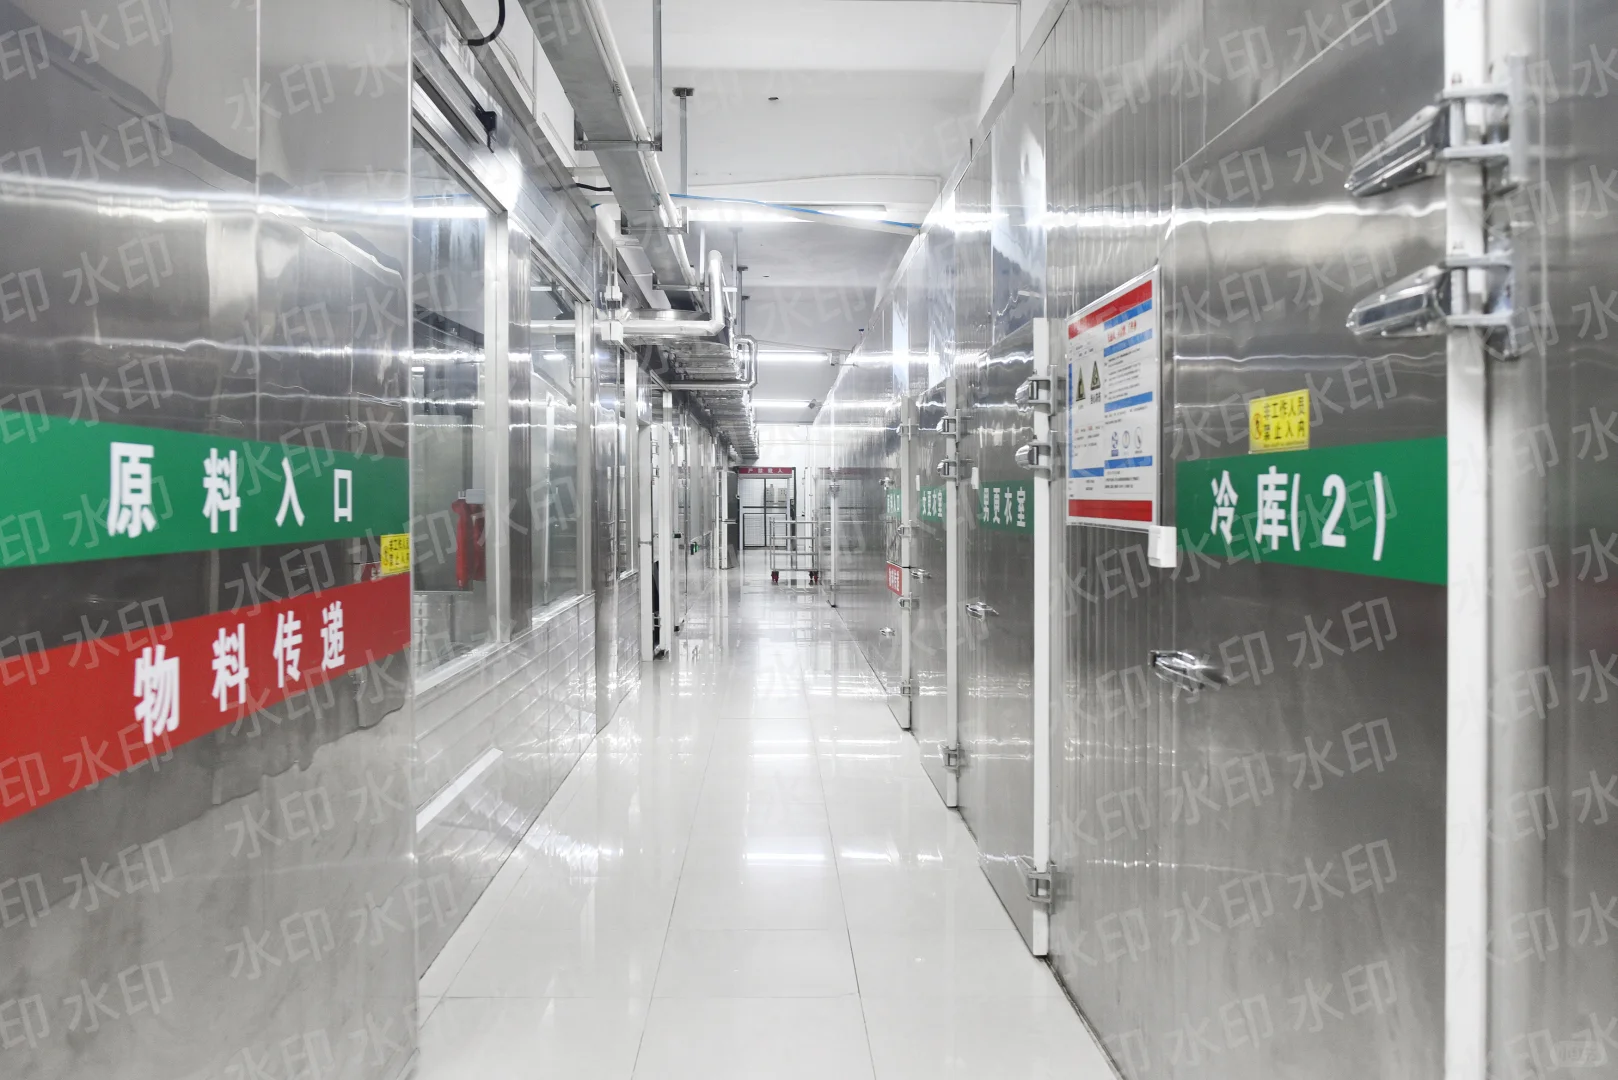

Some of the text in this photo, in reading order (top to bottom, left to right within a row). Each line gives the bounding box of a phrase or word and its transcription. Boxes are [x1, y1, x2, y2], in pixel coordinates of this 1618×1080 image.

[107, 442, 353, 538] 原料入口
[983, 486, 1026, 527] 男更衣室
[134, 600, 346, 743] 物料传递
